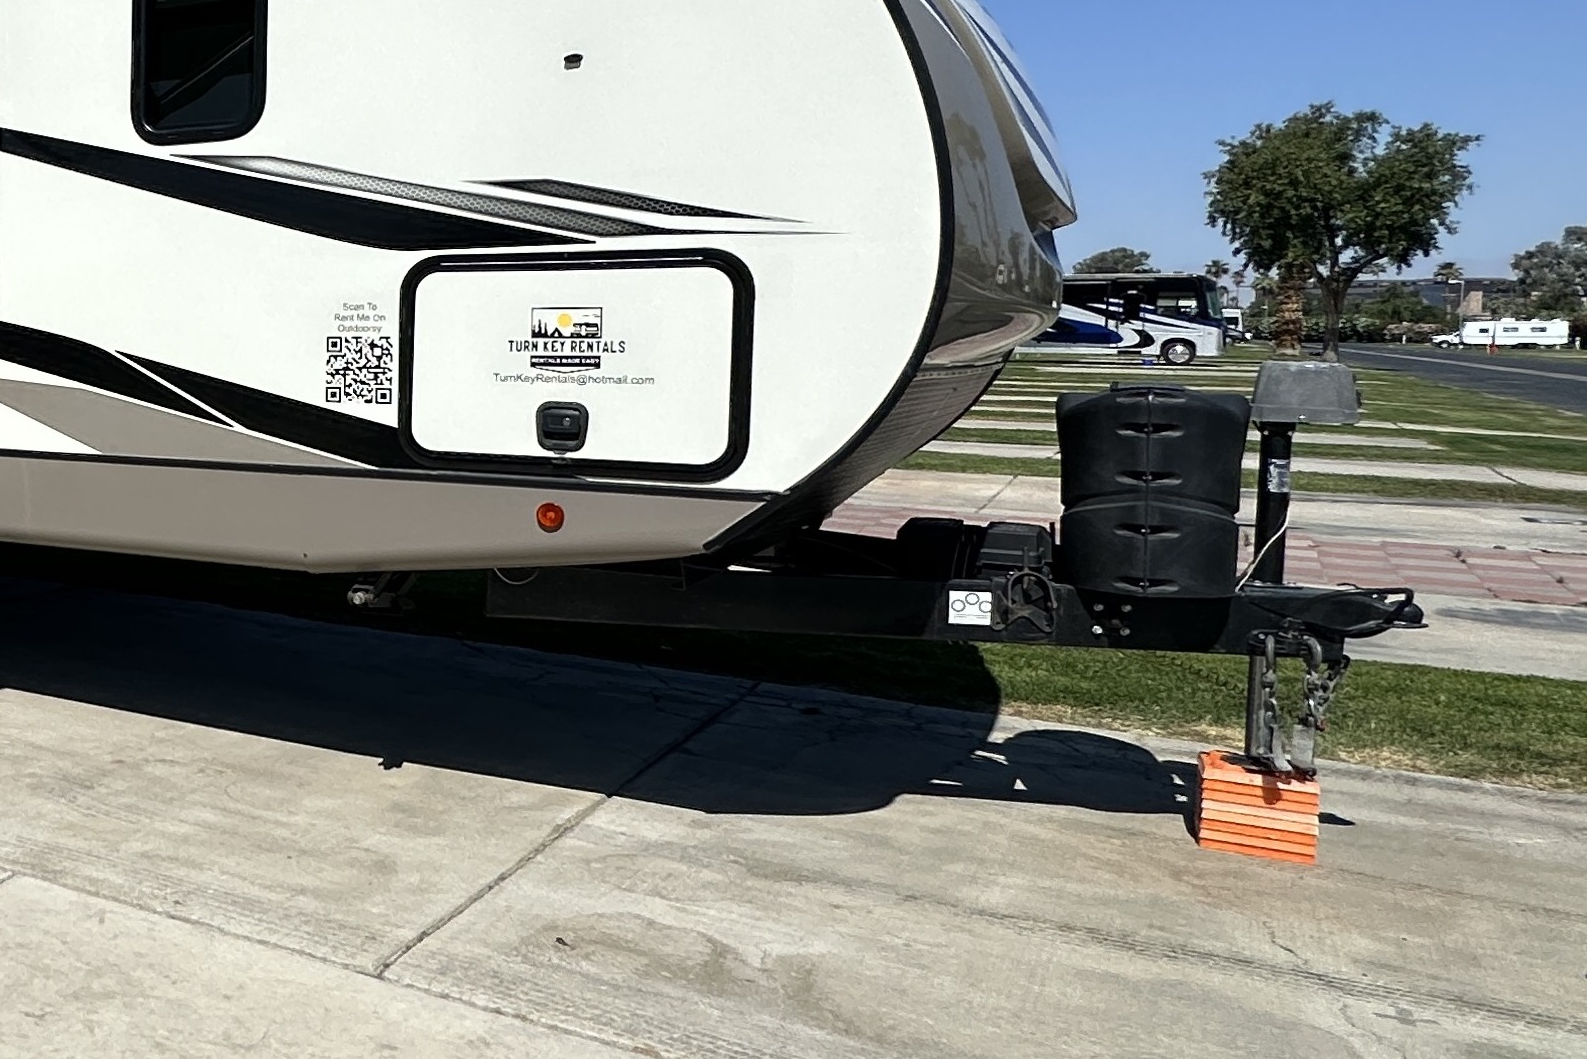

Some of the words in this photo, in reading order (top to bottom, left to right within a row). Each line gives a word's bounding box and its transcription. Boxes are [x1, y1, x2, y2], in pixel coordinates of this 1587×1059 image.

[342, 302, 365, 311] Scan
[367, 302, 378, 311] To
[334, 313, 355, 322] Rent
[356, 313, 371, 322] Me
[372, 314, 387, 322] On
[508, 340, 539, 353] TURN
[543, 341, 566, 353] KEY
[570, 341, 626, 354] RENTALS
